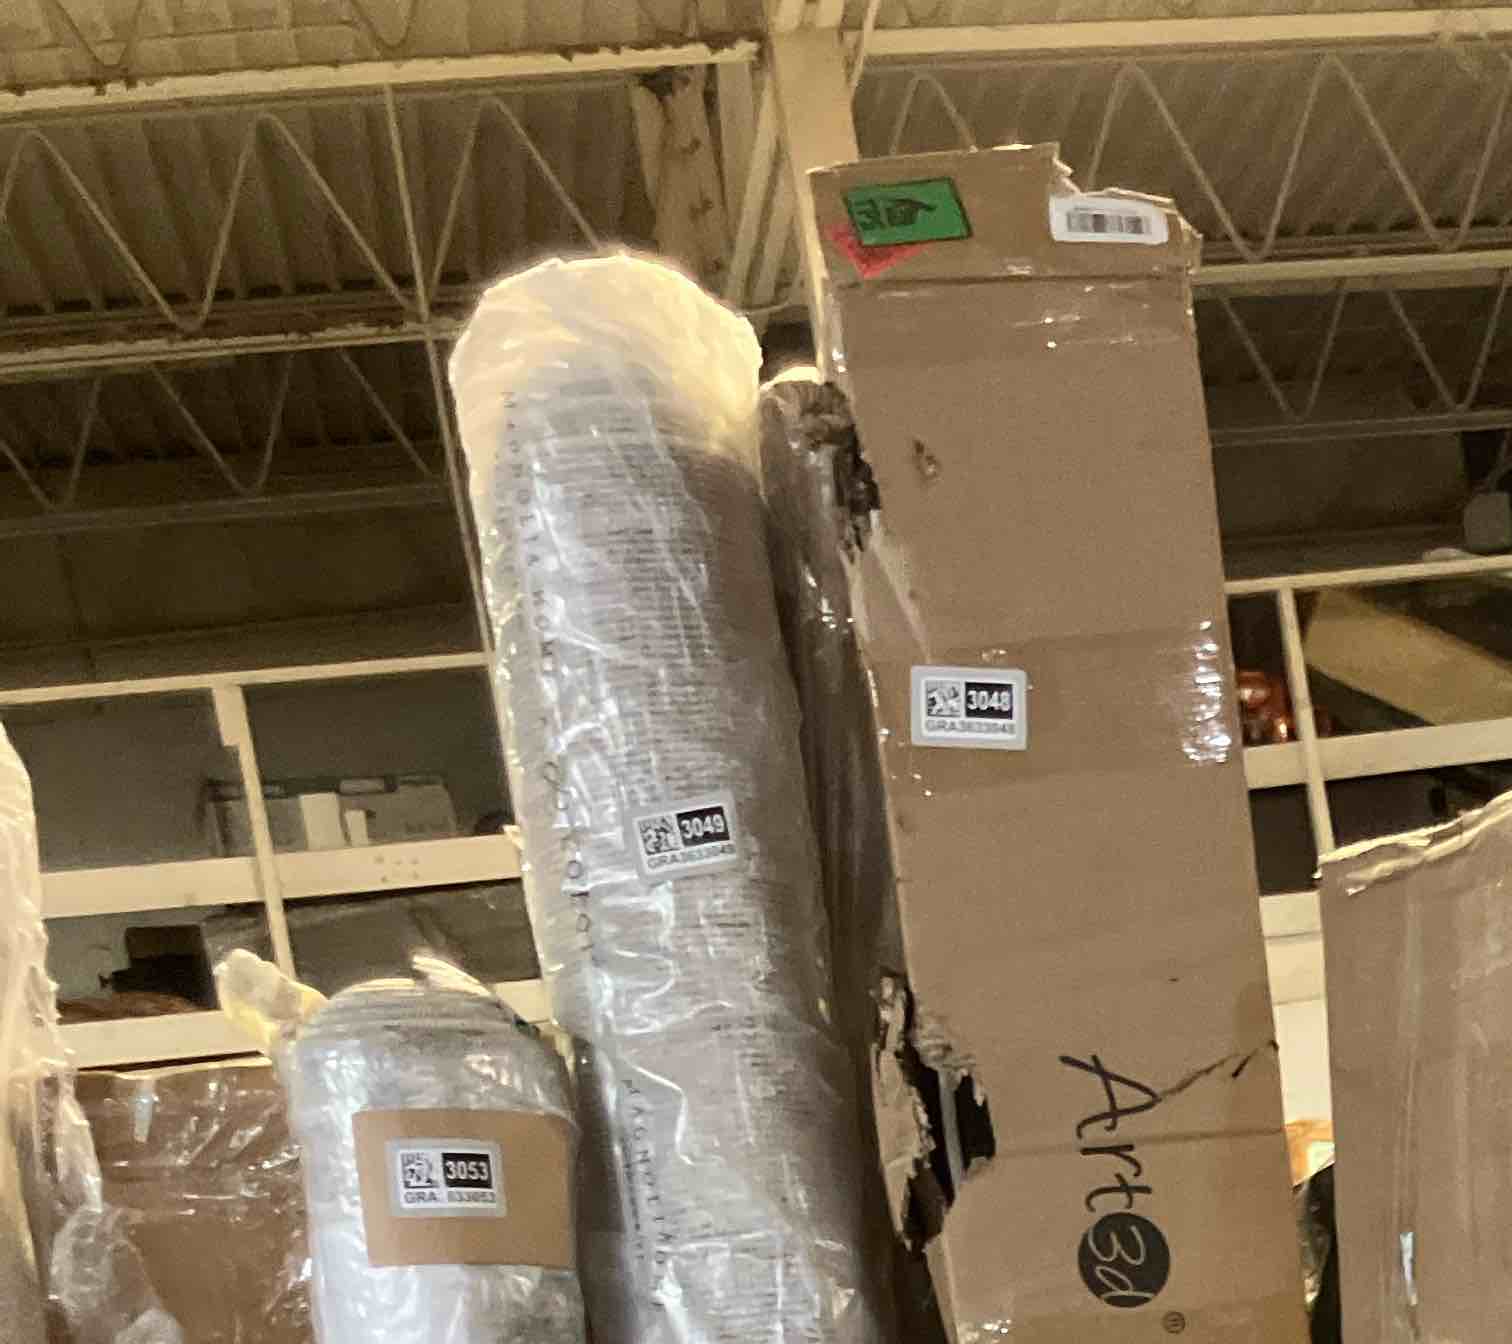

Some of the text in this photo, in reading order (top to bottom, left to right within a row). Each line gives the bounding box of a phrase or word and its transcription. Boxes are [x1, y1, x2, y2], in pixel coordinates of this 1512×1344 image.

[966, 690, 1011, 711] 3048
[681, 814, 725, 839] 3049
[446, 1160, 490, 1181] 3053
